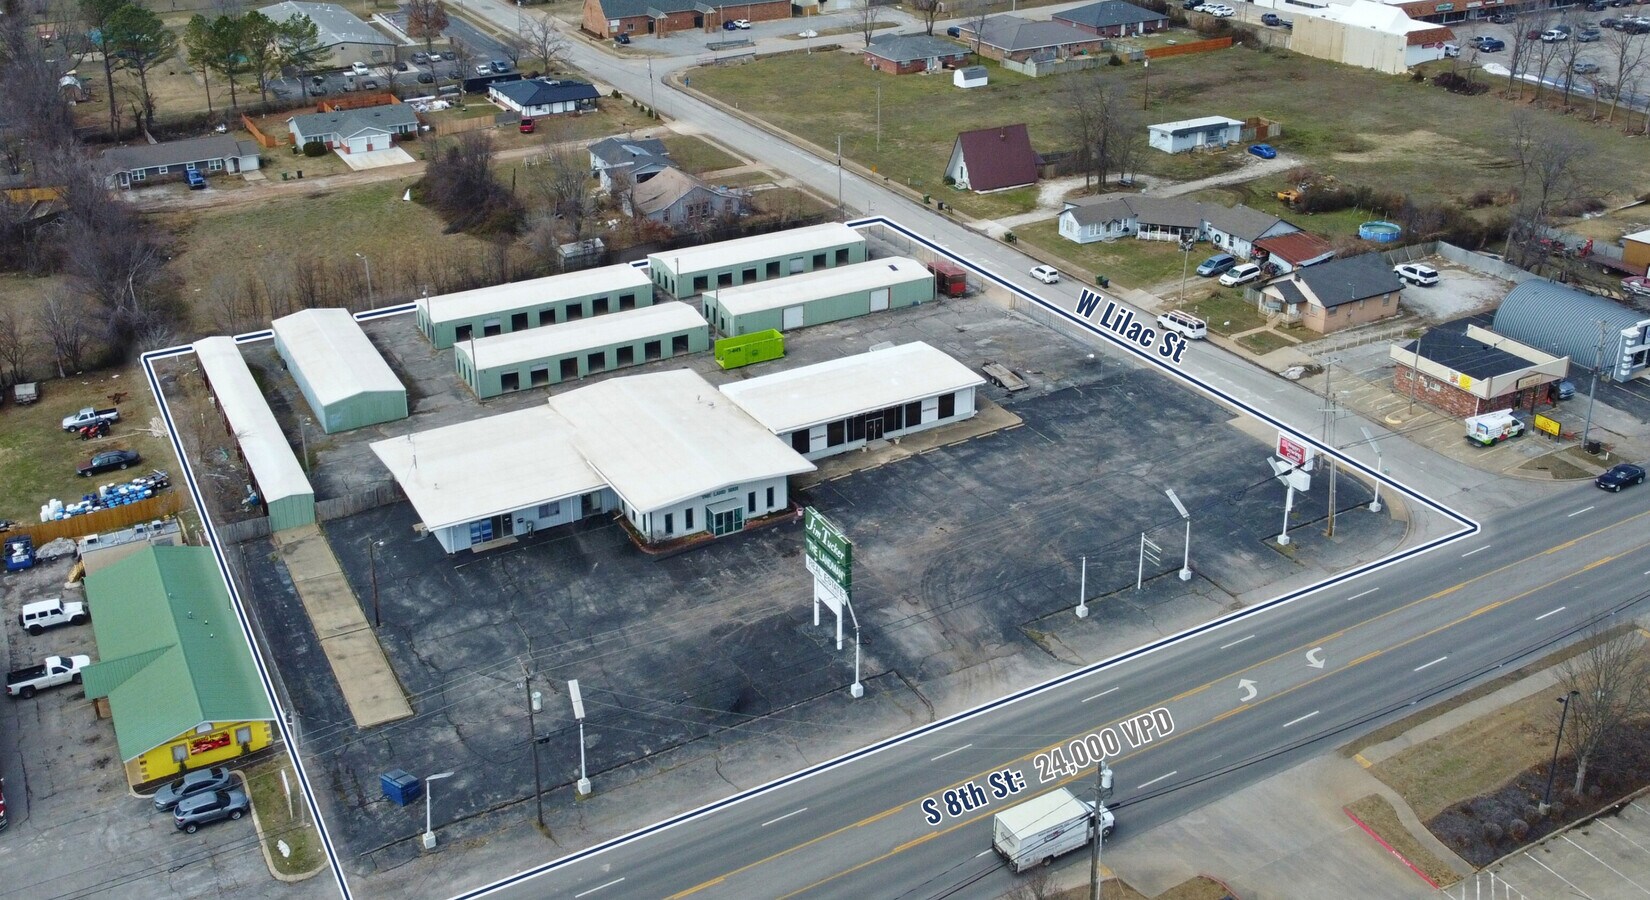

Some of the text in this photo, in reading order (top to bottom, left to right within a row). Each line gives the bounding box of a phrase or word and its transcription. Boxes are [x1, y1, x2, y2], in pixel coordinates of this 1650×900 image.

[806, 516, 845, 559] Jim Tucker
[806, 538, 818, 557] THE
[808, 558, 845, 598] REAL ESTATE
